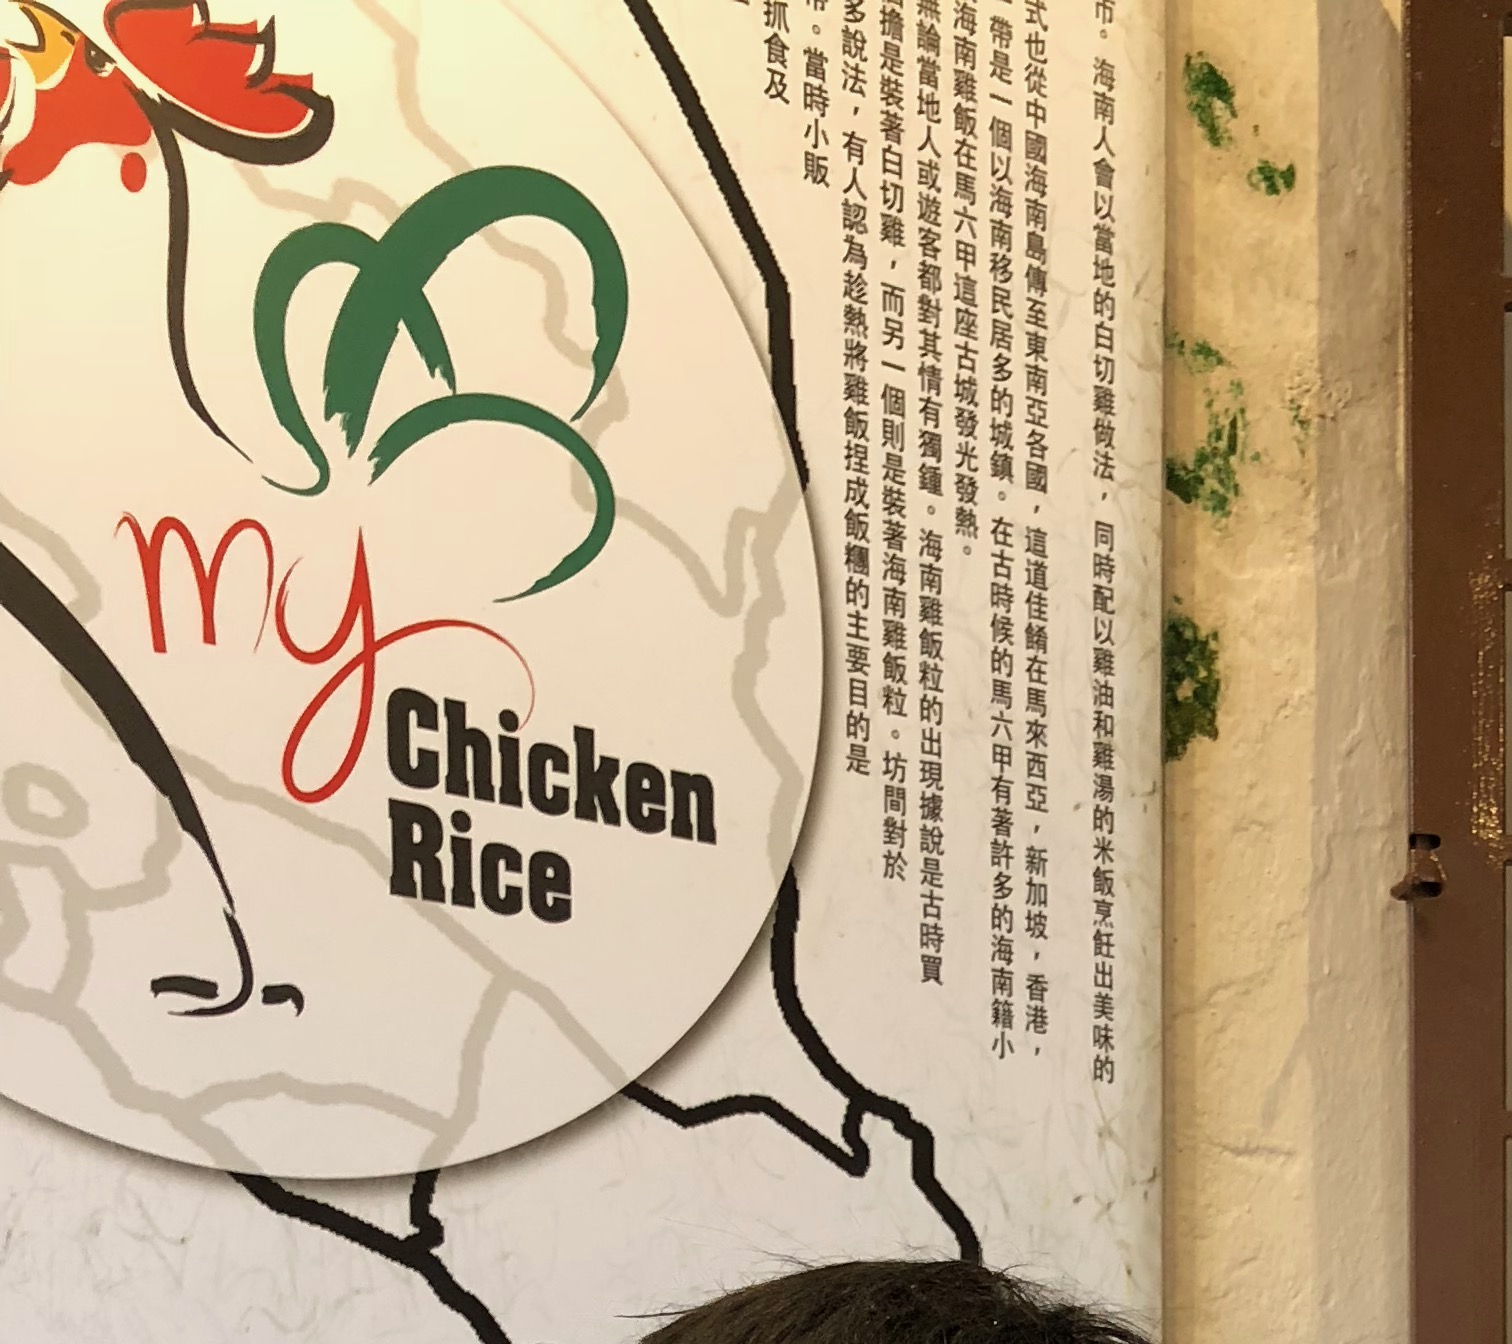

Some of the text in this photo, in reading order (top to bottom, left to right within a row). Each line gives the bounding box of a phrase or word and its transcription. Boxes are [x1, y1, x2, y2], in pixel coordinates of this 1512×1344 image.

[880, 0, 908, 881] 擔是裝著白切雞，而另一個則是裝著海南雞飯粒。坊間對於
[953, 0, 979, 556] 海南雞飯在馬六甲這座古城發光發熱。
[387, 688, 717, 846] Chicken
[388, 797, 574, 923] Rice
